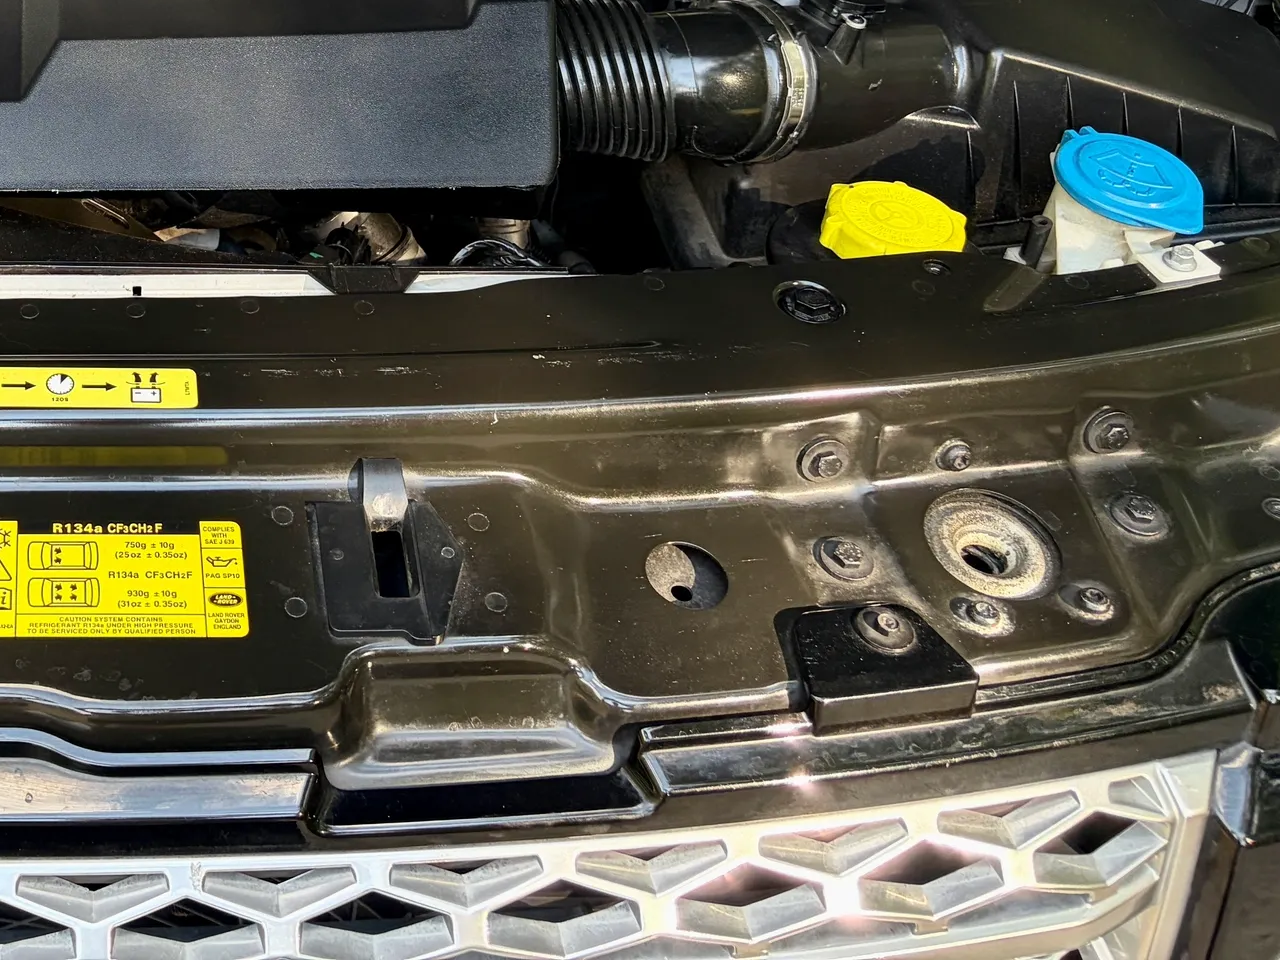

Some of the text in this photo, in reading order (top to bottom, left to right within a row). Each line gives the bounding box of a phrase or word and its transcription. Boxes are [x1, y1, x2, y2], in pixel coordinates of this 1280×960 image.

[52, 523, 103, 534] R134a
[125, 541, 146, 550] 750g
[114, 551, 142, 560] (25oz
[127, 590, 150, 599] 930g
[117, 600, 142, 608] (31oz
